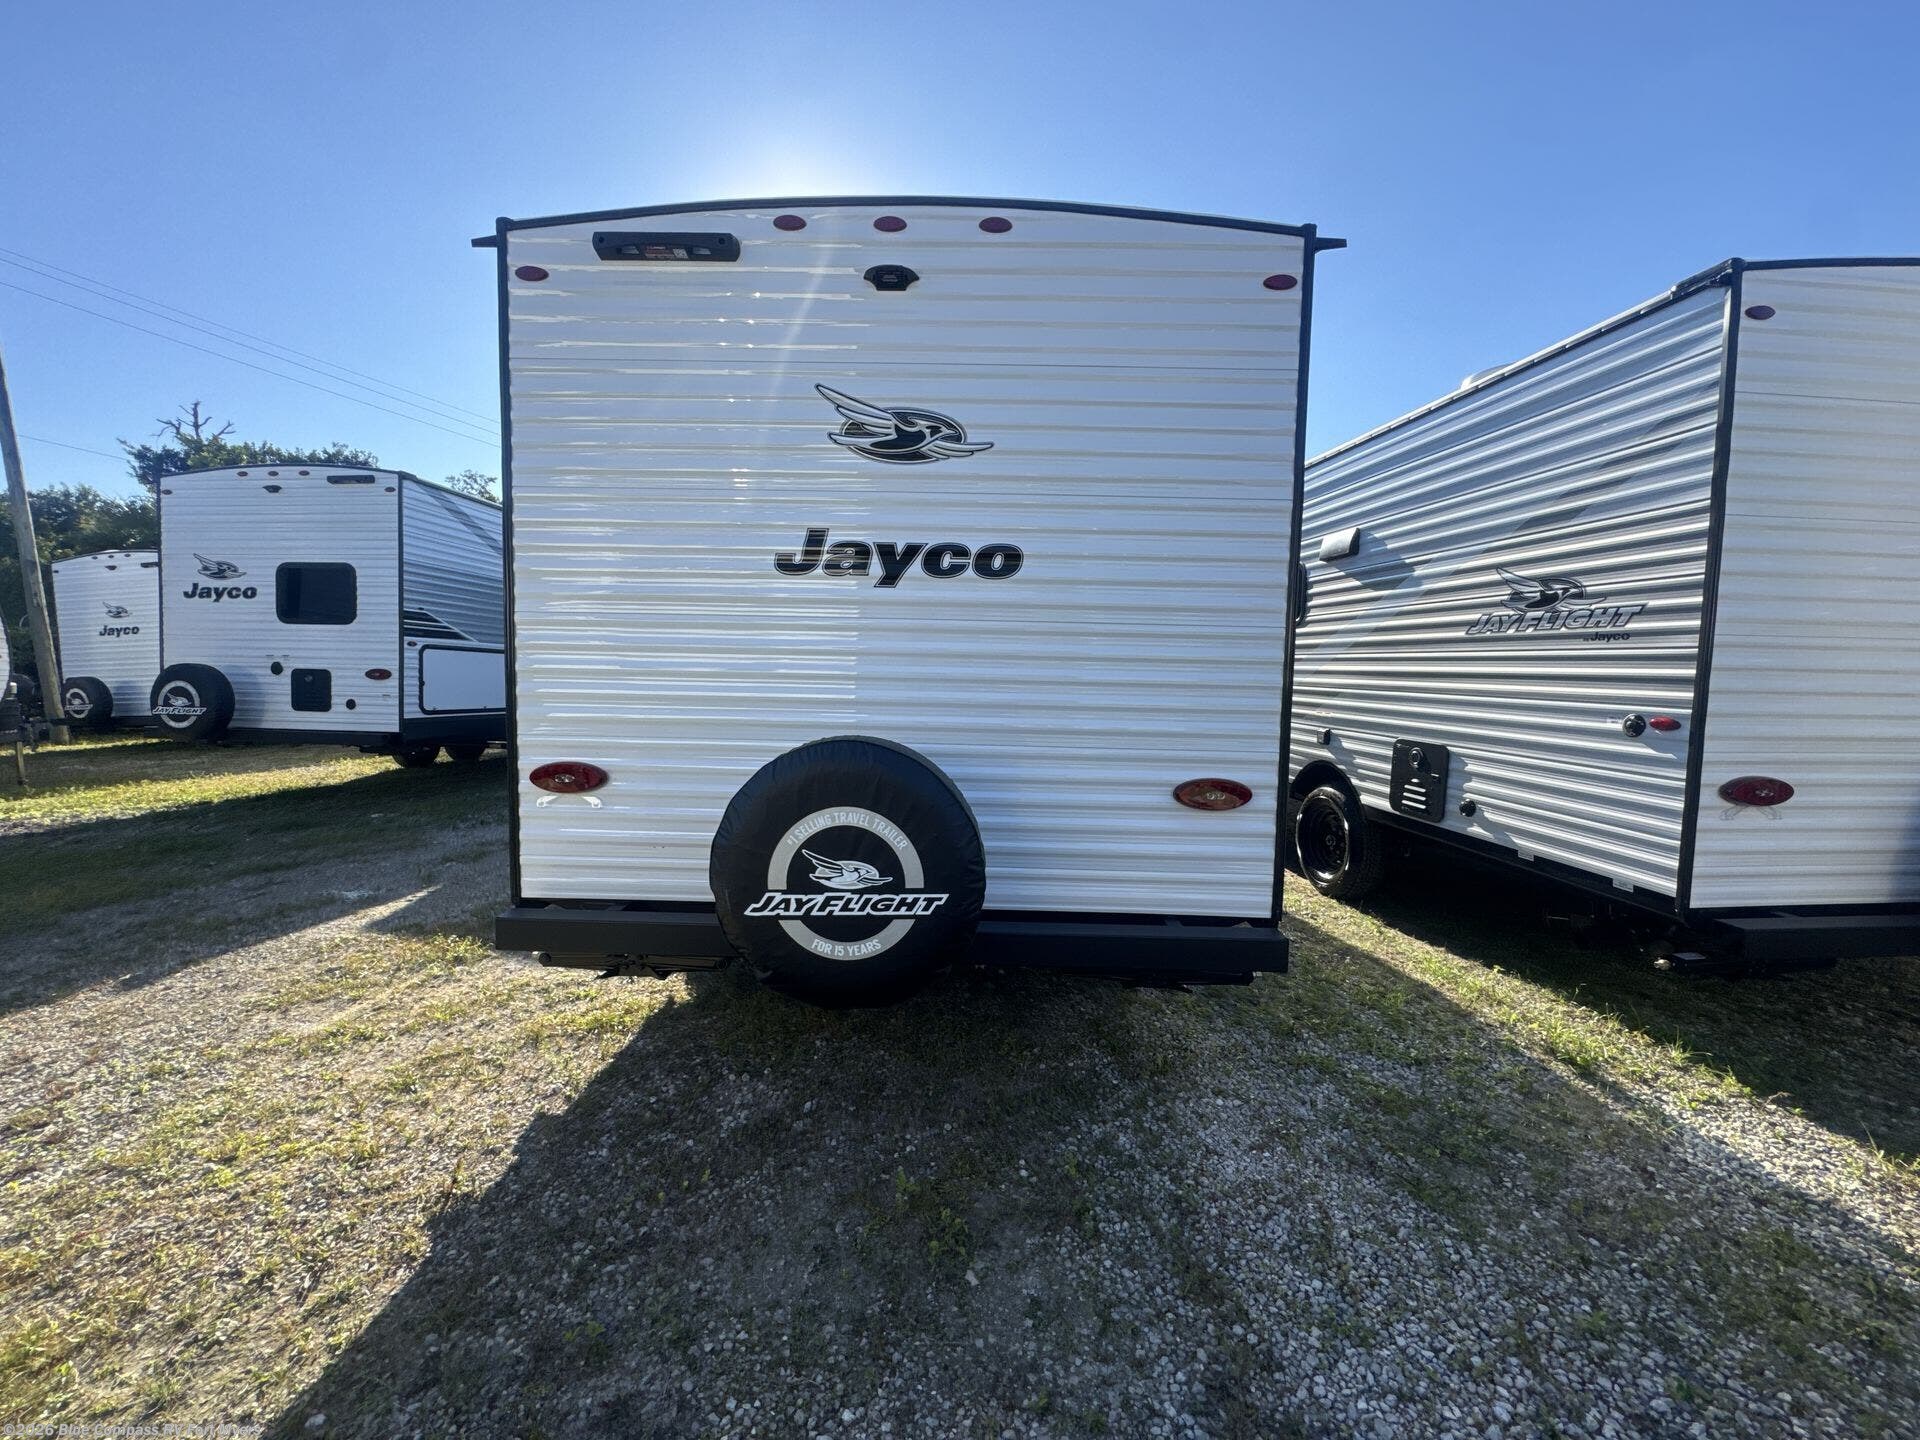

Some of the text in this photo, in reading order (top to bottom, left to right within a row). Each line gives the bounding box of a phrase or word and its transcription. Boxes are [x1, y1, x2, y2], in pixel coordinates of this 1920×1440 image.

[774, 528, 1024, 588] Jayco
[183, 583, 258, 603] Jayco
[99, 625, 140, 638] Jayco
[1590, 631, 1631, 643] Jayco
[796, 814, 832, 838] SELLING
[833, 812, 869, 827] TRAVEL
[872, 818, 908, 850] TRAILER
[811, 939, 882, 956] FOR 15 YEARS
